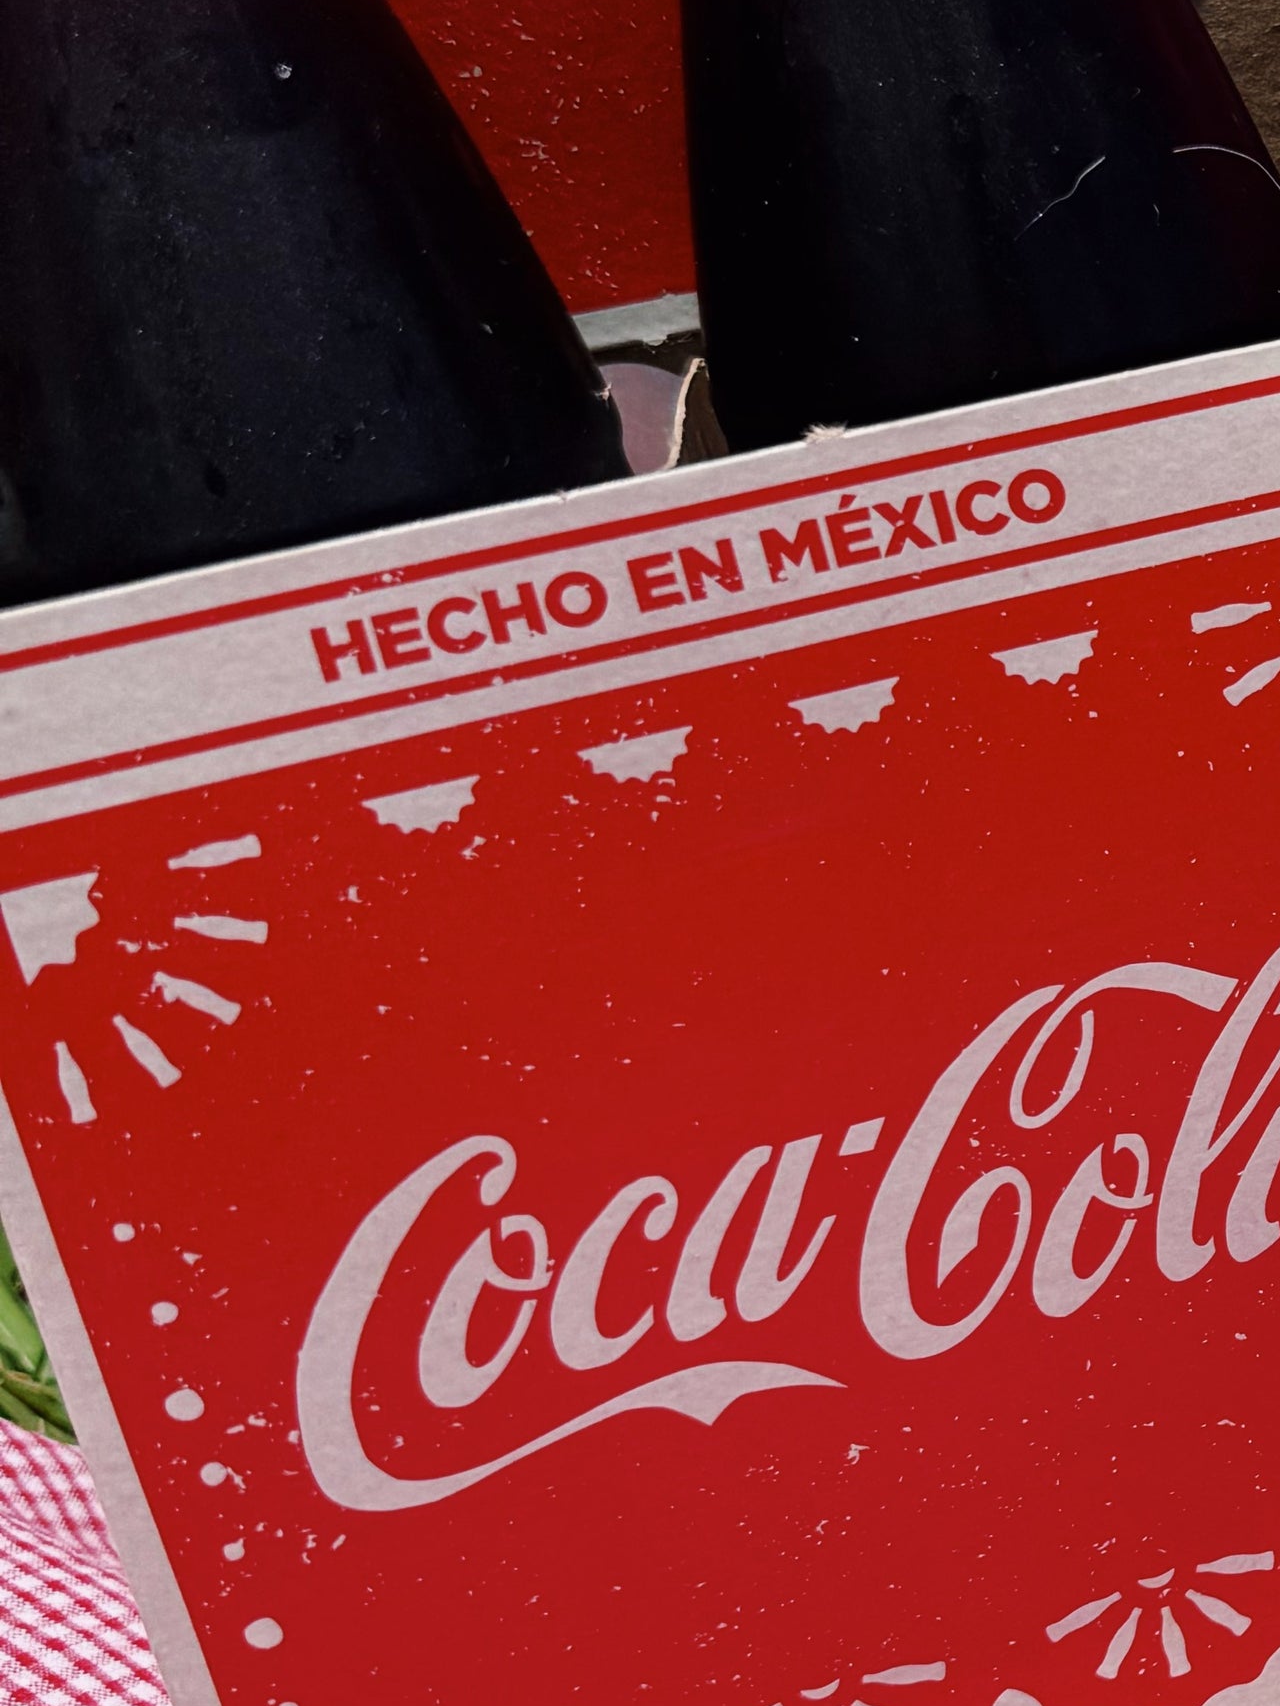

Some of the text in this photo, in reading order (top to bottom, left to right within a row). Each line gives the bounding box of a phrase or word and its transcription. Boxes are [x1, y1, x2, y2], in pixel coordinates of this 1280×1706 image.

[308, 468, 1066, 684] HECHO EN MÉXICO
